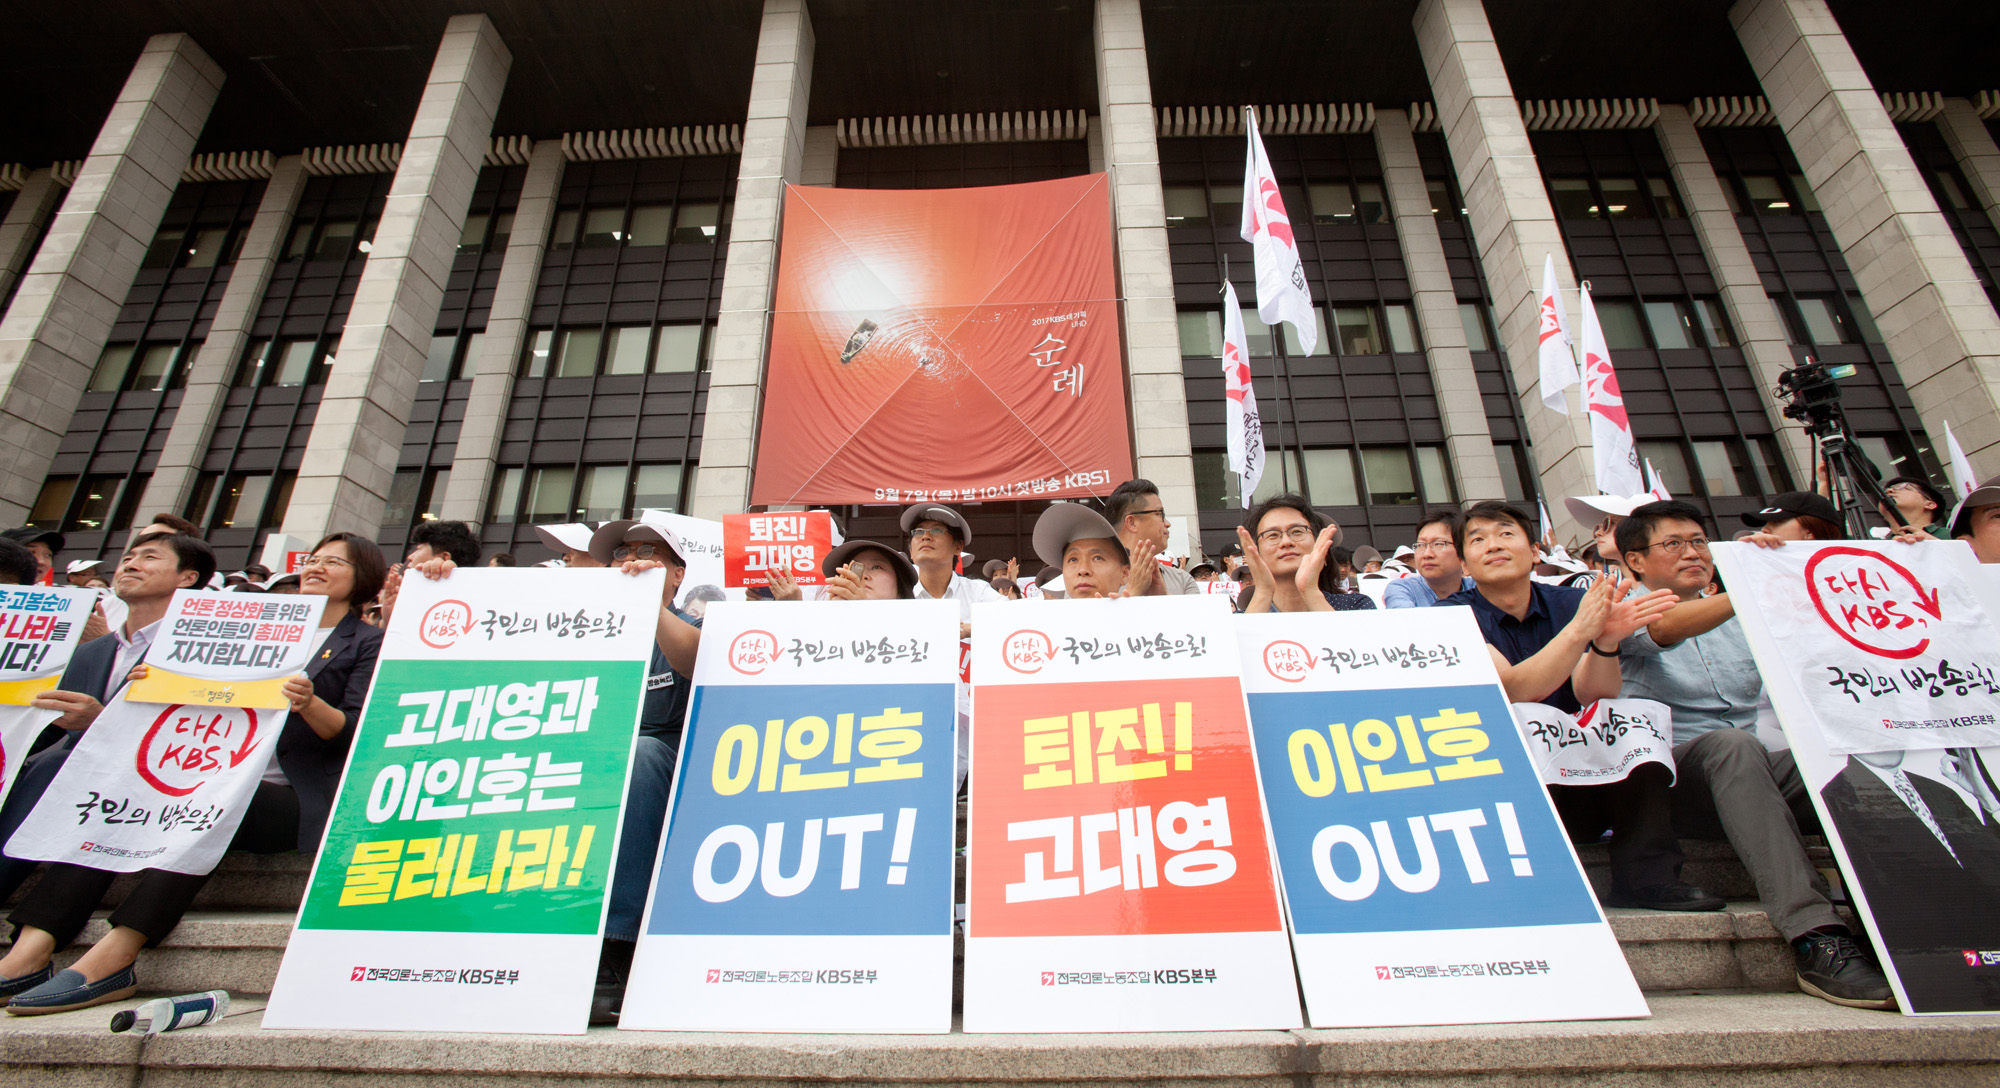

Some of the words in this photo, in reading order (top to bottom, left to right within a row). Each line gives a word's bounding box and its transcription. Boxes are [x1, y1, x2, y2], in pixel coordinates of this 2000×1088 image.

[1071, 320, 1087, 328] UHD
[1028, 332, 1084, 398] 순례
[874, 488, 899, 500] 9월
[962, 488, 976, 500] 밤
[979, 486, 1012, 499] 10시
[1014, 477, 1061, 495] 첫방송
[1065, 469, 1111, 488] KBS1
[750, 516, 807, 542] 퇴진!
[711, 544, 724, 558] 방
[744, 545, 815, 571] 고대영
[1824, 568, 1890, 600] 다시
[181, 598, 216, 616] 언론
[215, 600, 279, 621] 정상화를
[279, 603, 312, 621] 위한
[433, 608, 460, 622] 다시
[481, 609, 537, 640] 국민의
[546, 608, 626, 638] 방송으로!
[4, 614, 72, 641] 나라를
[172, 618, 256, 640] 언론인들의
[254, 623, 305, 642] 총파업
[166, 640, 290, 669] 지지합니다!
[741, 639, 766, 650] 다시
[788, 639, 844, 667] 국민의
[851, 636, 928, 664] 방송으로!
[1013, 640, 1040, 650] 다시
[1062, 637, 1121, 665] 국민의
[1127, 632, 1207, 660] 방송으로!
[1272, 650, 1299, 659] 다시
[1322, 648, 1379, 674] 국민의
[1381, 643, 1460, 668] 방송으로!
[1826, 666, 1900, 703] 국민의
[1900, 659, 2000, 697] 방송으로!
[207, 691, 235, 703] 정의당
[384, 676, 599, 748] 고대영과
[175, 713, 232, 744] 다시
[1528, 720, 1588, 752] 국민의
[1949, 714, 1996, 728] KBS본부
[158, 743, 222, 774] KBS,
[711, 707, 923, 796] 이인호
[1023, 702, 1192, 790] 퇴진!
[1287, 707, 1504, 798] 이인호
[366, 752, 583, 824] 이인호는
[76, 791, 151, 825] 국민의
[338, 824, 596, 907] 물러나라!
[692, 808, 917, 903] OUT!
[1005, 796, 1237, 904] 고대영
[1311, 802, 1534, 901] OUT!
[367, 968, 457, 984] 전국언론노동조합
[458, 968, 519, 985] KBS본부
[722, 969, 813, 984] 전국언론노동조합
[816, 969, 878, 985] KBS본부
[1057, 971, 1150, 986] 전국언론노동조합
[1153, 968, 1217, 985] KBS본부
[1391, 964, 1485, 978] 전국언론노동조합
[1486, 960, 1550, 976] KBS본부
